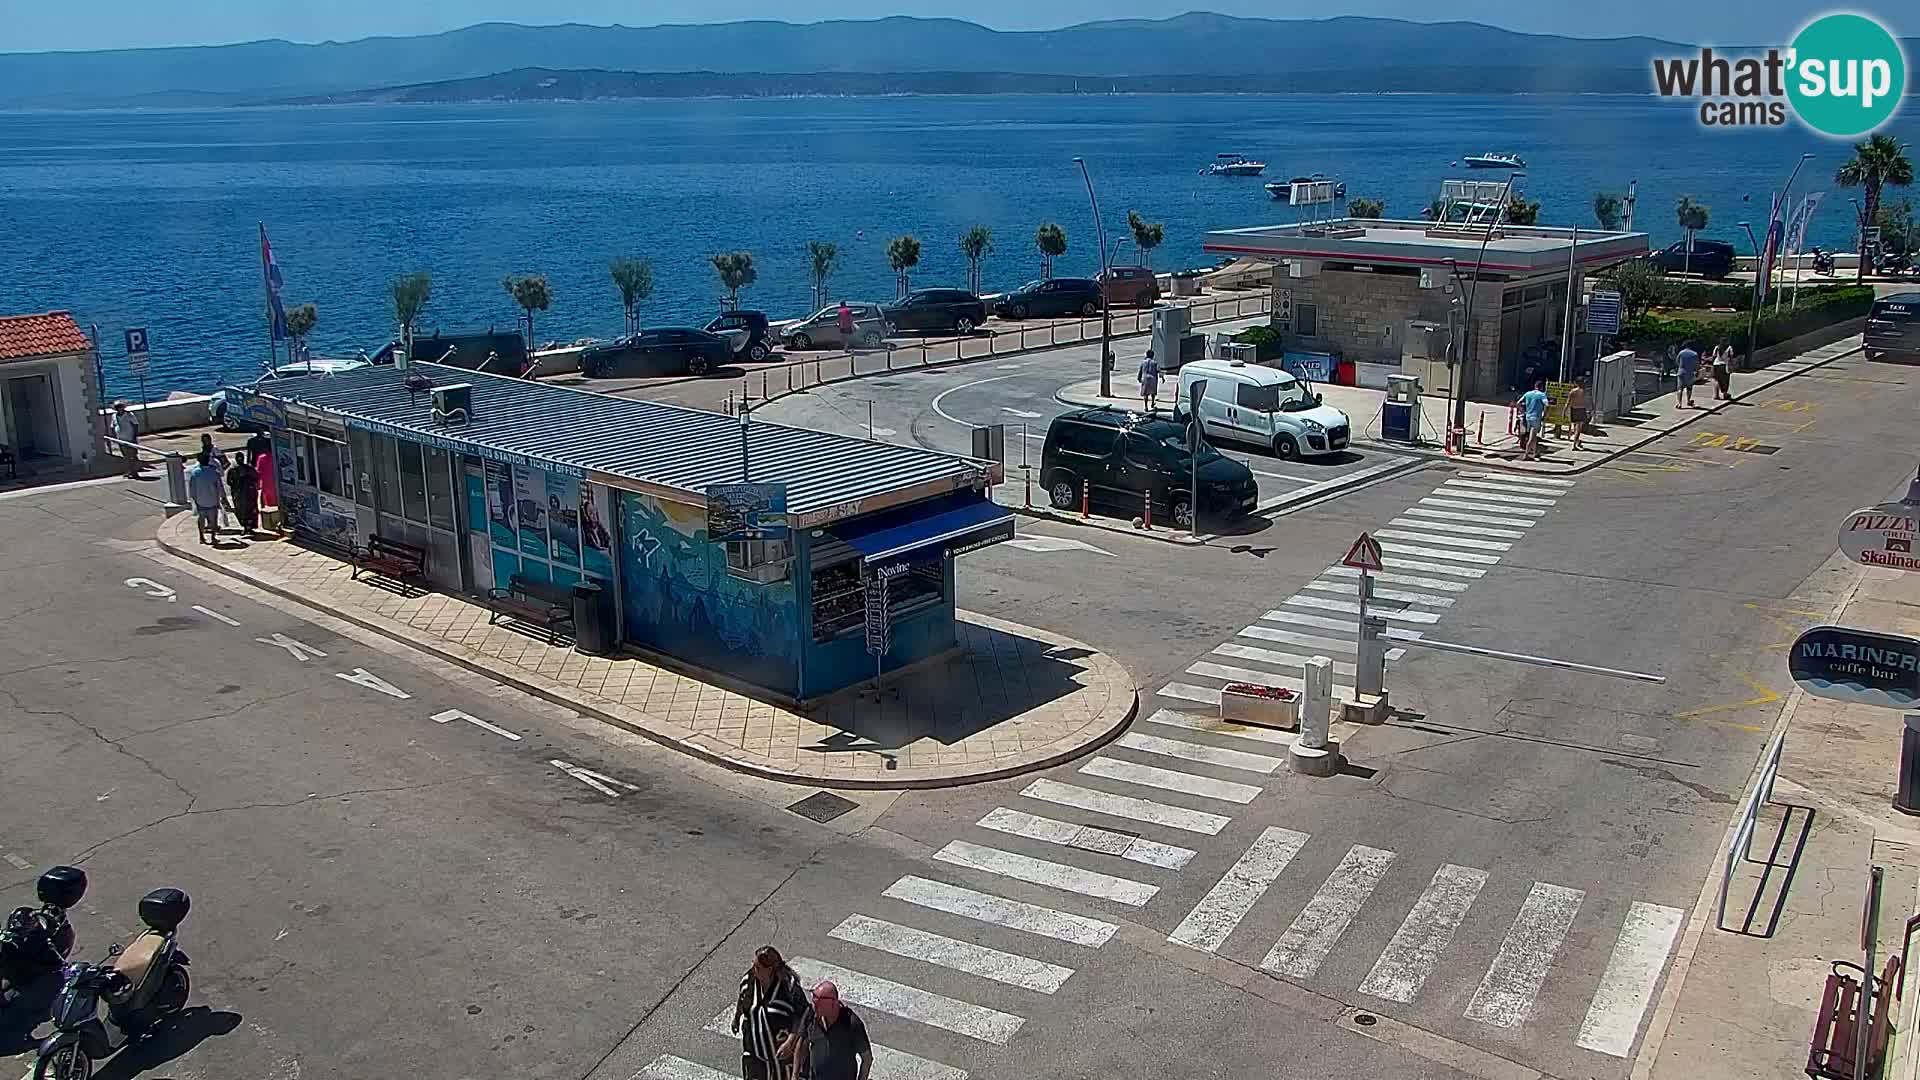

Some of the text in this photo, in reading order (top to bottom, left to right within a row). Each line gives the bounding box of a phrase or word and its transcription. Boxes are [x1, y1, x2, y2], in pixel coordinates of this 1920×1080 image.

[129, 331, 142, 350] P
[437, 437, 468, 453] POSTAJA
[478, 447, 492, 458] BUS
[494, 450, 526, 465] STATION
[529, 457, 554, 472] TICKET
[555, 462, 582, 477] OFFICE
[1849, 515, 1920, 533] PIZZE
[1829, 662, 1899, 680] caffe bar
